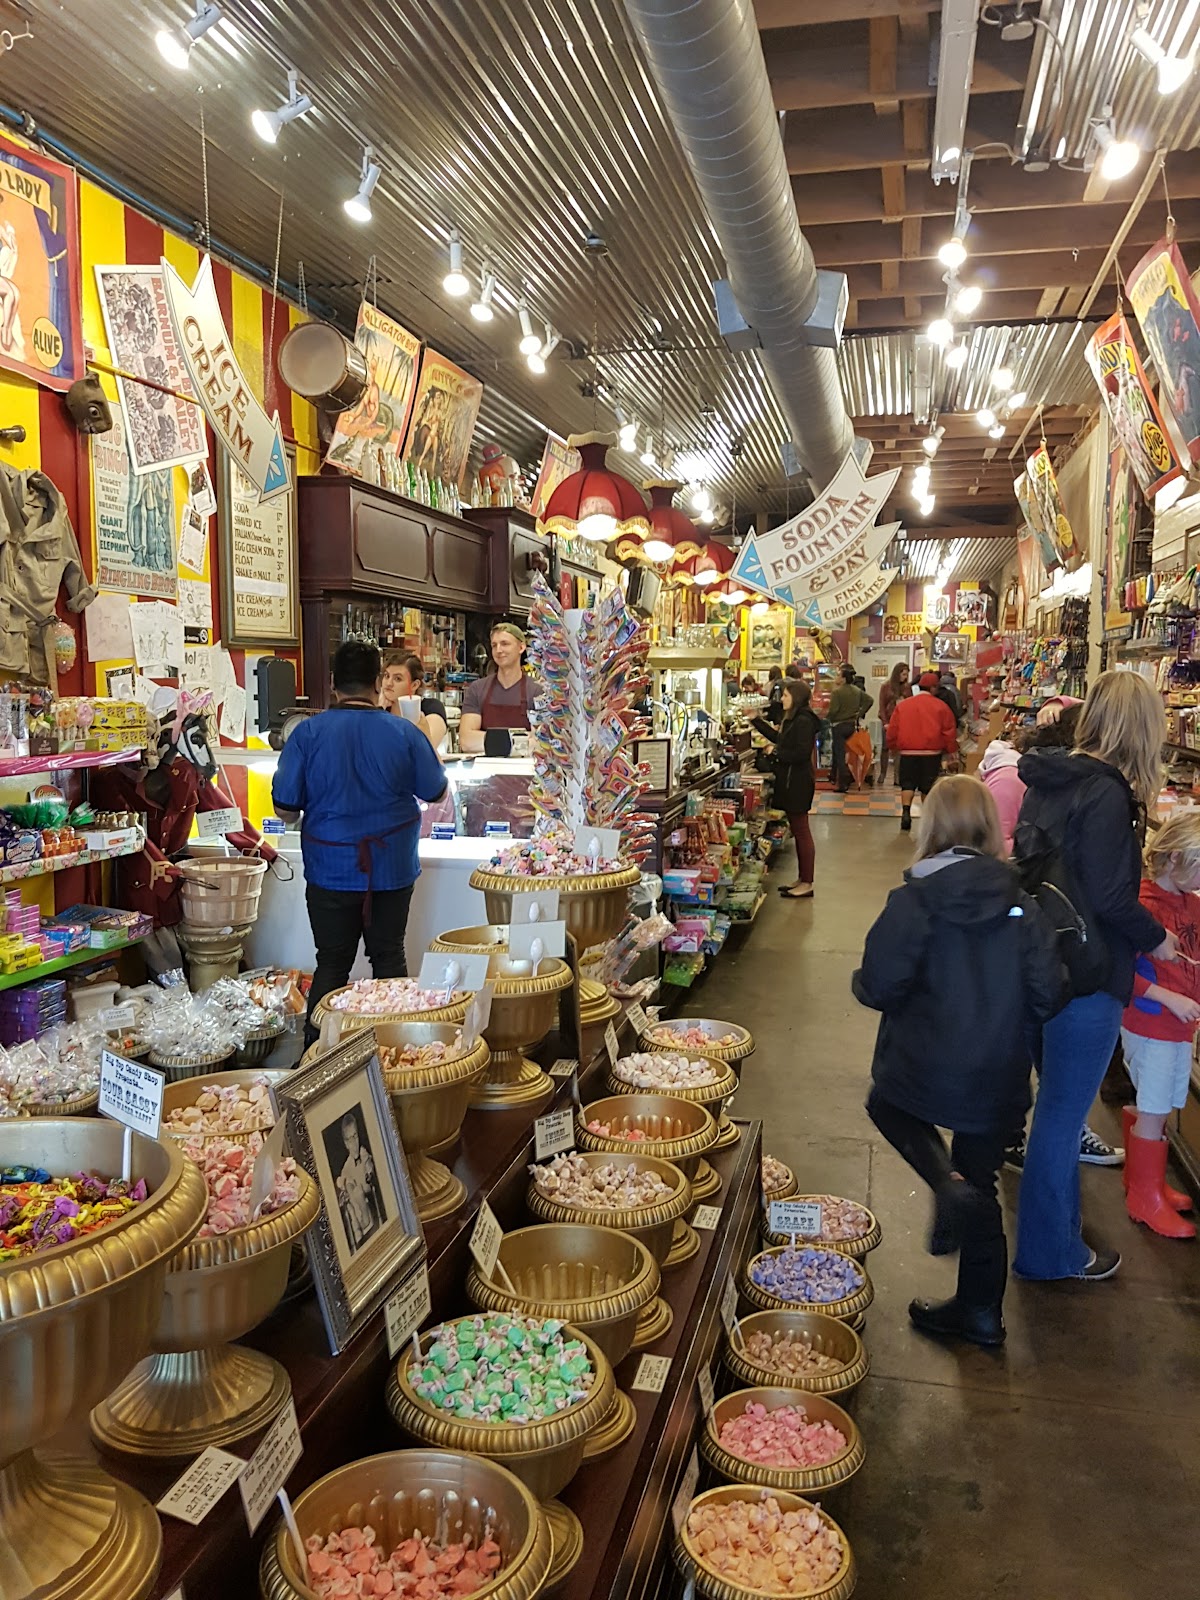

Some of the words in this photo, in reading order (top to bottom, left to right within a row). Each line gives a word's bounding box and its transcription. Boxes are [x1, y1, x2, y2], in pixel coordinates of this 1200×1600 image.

[7, 174, 42, 204] LADY
[151, 277, 175, 361] BARNUM
[365, 311, 406, 344] ALLIGATOR
[405, 338, 417, 352] BOY
[33, 329, 60, 358] ALIVE
[168, 365, 179, 380] &
[212, 340, 250, 421] ICE
[184, 316, 254, 464] CREAM
[172, 385, 192, 450] BAILEY
[96, 444, 128, 476] BINGO
[104, 494, 118, 502] THAT
[234, 502, 249, 514] SODA
[100, 528, 126, 540] TWO-STORY
[101, 514, 123, 528] GIANT
[234, 516, 252, 527] SHAVED
[254, 519, 262, 530] ICE
[771, 491, 877, 580] FOUNTAIN
[782, 495, 849, 550] SODA
[100, 540, 129, 554] ELEPHANT
[235, 541, 245, 552] EGG
[246, 544, 262, 555] CREAM
[264, 547, 275, 556] SODA
[235, 554, 253, 565] FLOAT
[101, 566, 150, 590] RINGLING
[236, 568, 252, 578] SHAKE
[258, 571, 270, 580] MALT
[809, 576, 829, 593] &
[832, 546, 869, 582] PAY
[246, 595, 262, 605] CREAM
[824, 576, 886, 620] CHOCOLATES
[835, 578, 866, 604] FINE
[237, 607, 245, 616] ICE
[247, 608, 263, 618] CREAM
[902, 614, 922, 622] SELLS
[106, 1054, 114, 1066] Big
[116, 1060, 124, 1070] Top
[126, 1063, 142, 1078] Candy
[144, 1071, 159, 1086] Shop
[102, 1078, 123, 1101] SOUR
[125, 1090, 158, 1116] SASSY
[105, 1094, 115, 1105] SALT
[116, 1098, 133, 1116] WATER
[135, 1109, 152, 1124] TAFFY
[245, 1466, 254, 1481] Big
[256, 1451, 264, 1464] Top
[265, 1428, 278, 1450] Candy
[280, 1410, 290, 1427] Shop
[170, 1484, 189, 1501] SALT
[187, 1458, 210, 1481] WATER
[189, 1472, 211, 1493] TAFFY
[201, 1484, 212, 1496] per
[210, 1472, 222, 1482] 1/4
[249, 1430, 296, 1509] POMEGRANATE
